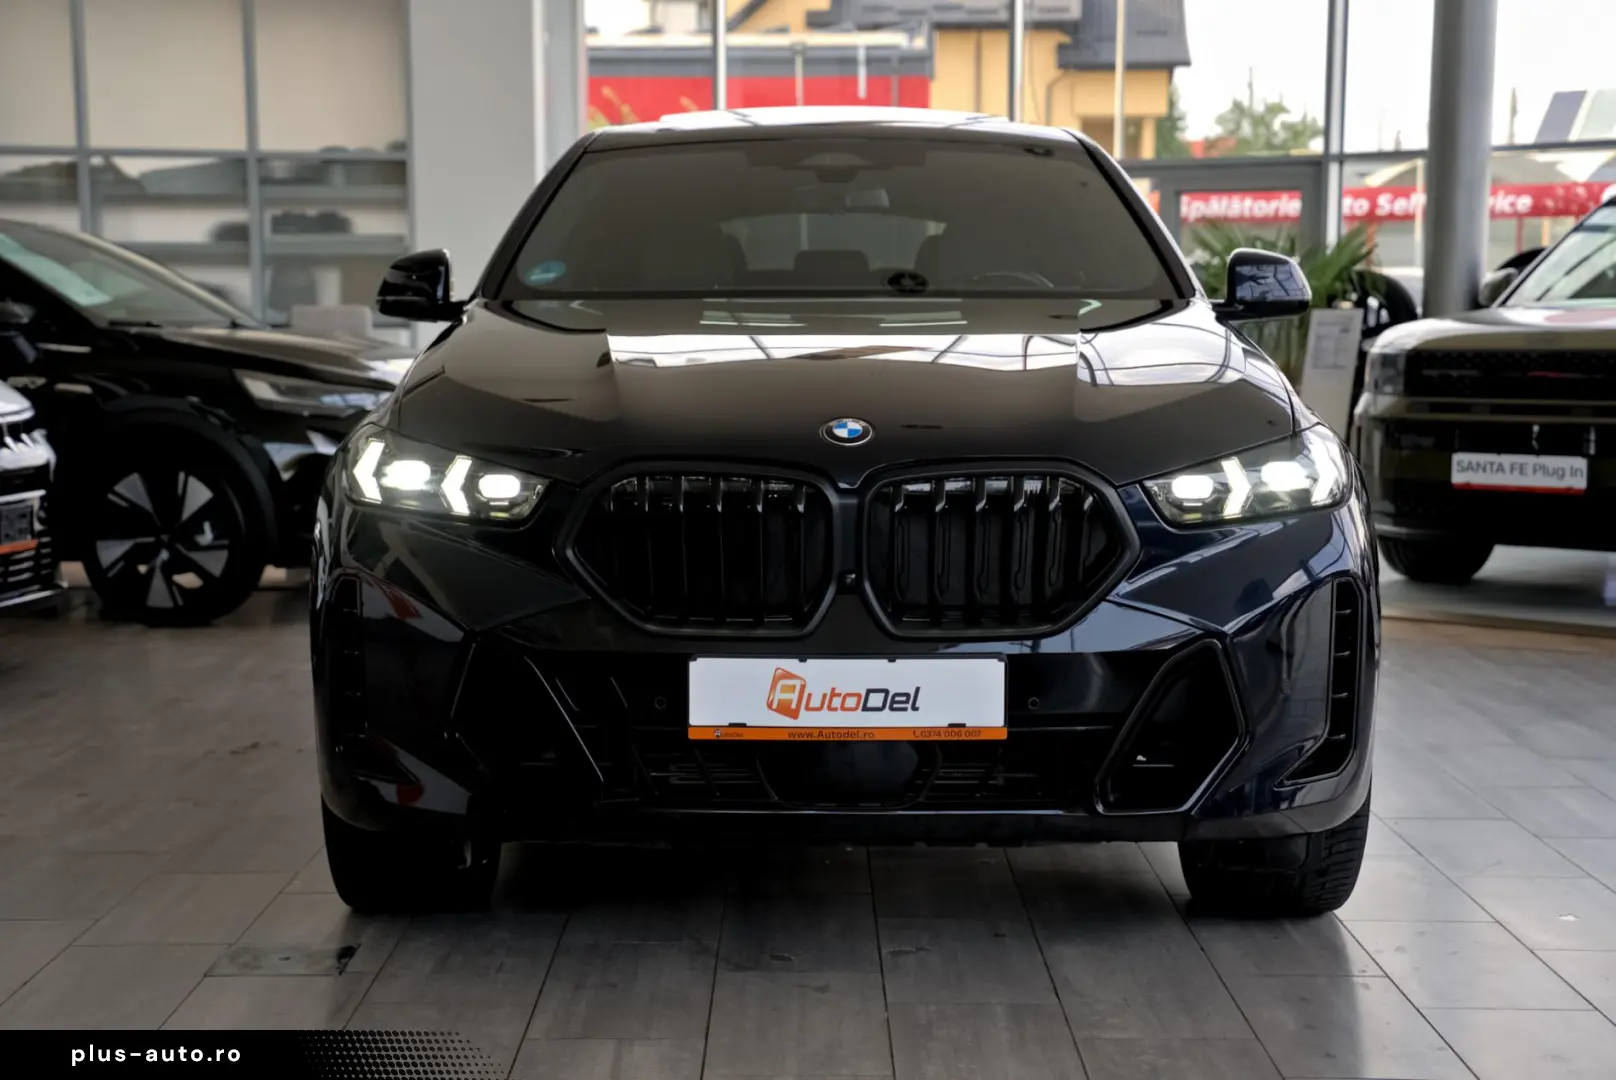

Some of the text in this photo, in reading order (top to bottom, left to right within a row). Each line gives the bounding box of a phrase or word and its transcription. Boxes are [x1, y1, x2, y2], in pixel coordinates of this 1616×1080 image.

[1456, 459, 1584, 481] SANTA FE Plug In
[770, 677, 921, 713] AutoDel
[788, 730, 875, 739] www.Autodel.ro
[920, 730, 942, 738] 0374
